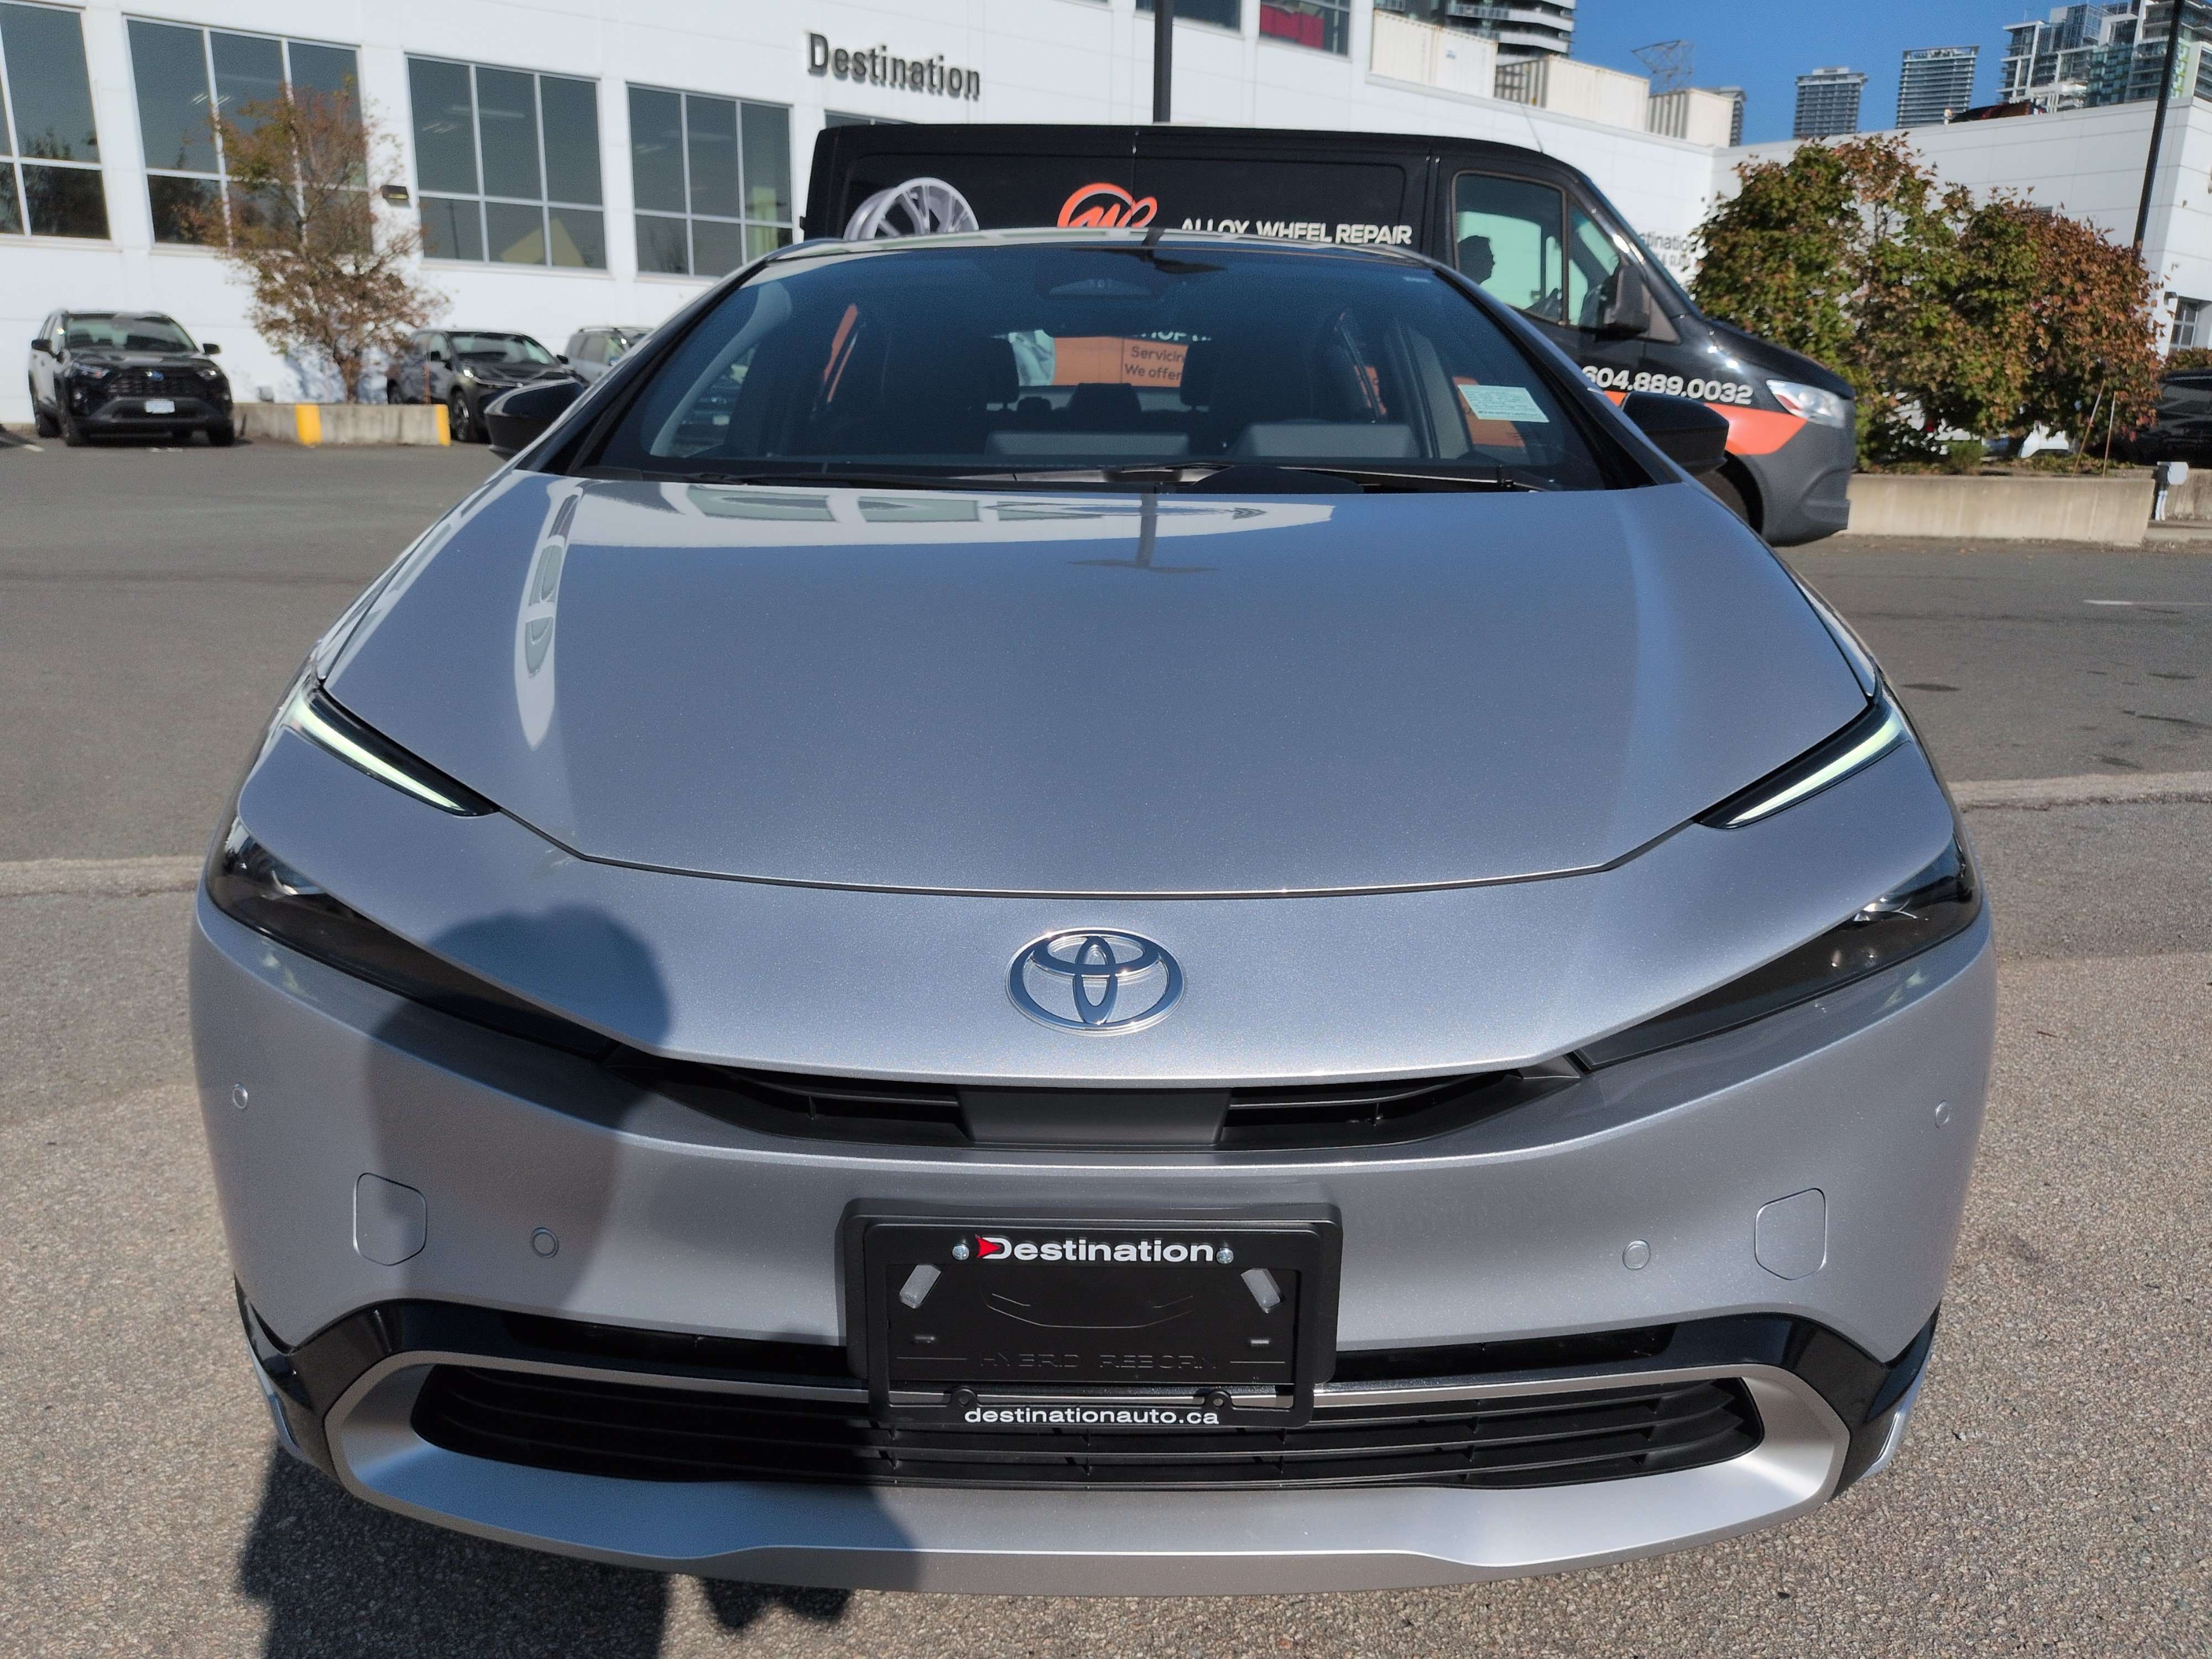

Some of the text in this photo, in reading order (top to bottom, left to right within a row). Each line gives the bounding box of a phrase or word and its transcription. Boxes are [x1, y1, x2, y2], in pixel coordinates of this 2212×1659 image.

[808, 32, 980, 98] Destination
[1181, 218, 1412, 244] ALLOY WHEEL REPAIR
[1131, 346, 1185, 362] Servicin
[1125, 363, 1182, 381] We offer
[981, 1236, 1214, 1262] Destination
[964, 1407, 1219, 1426] destinationauto.ca
